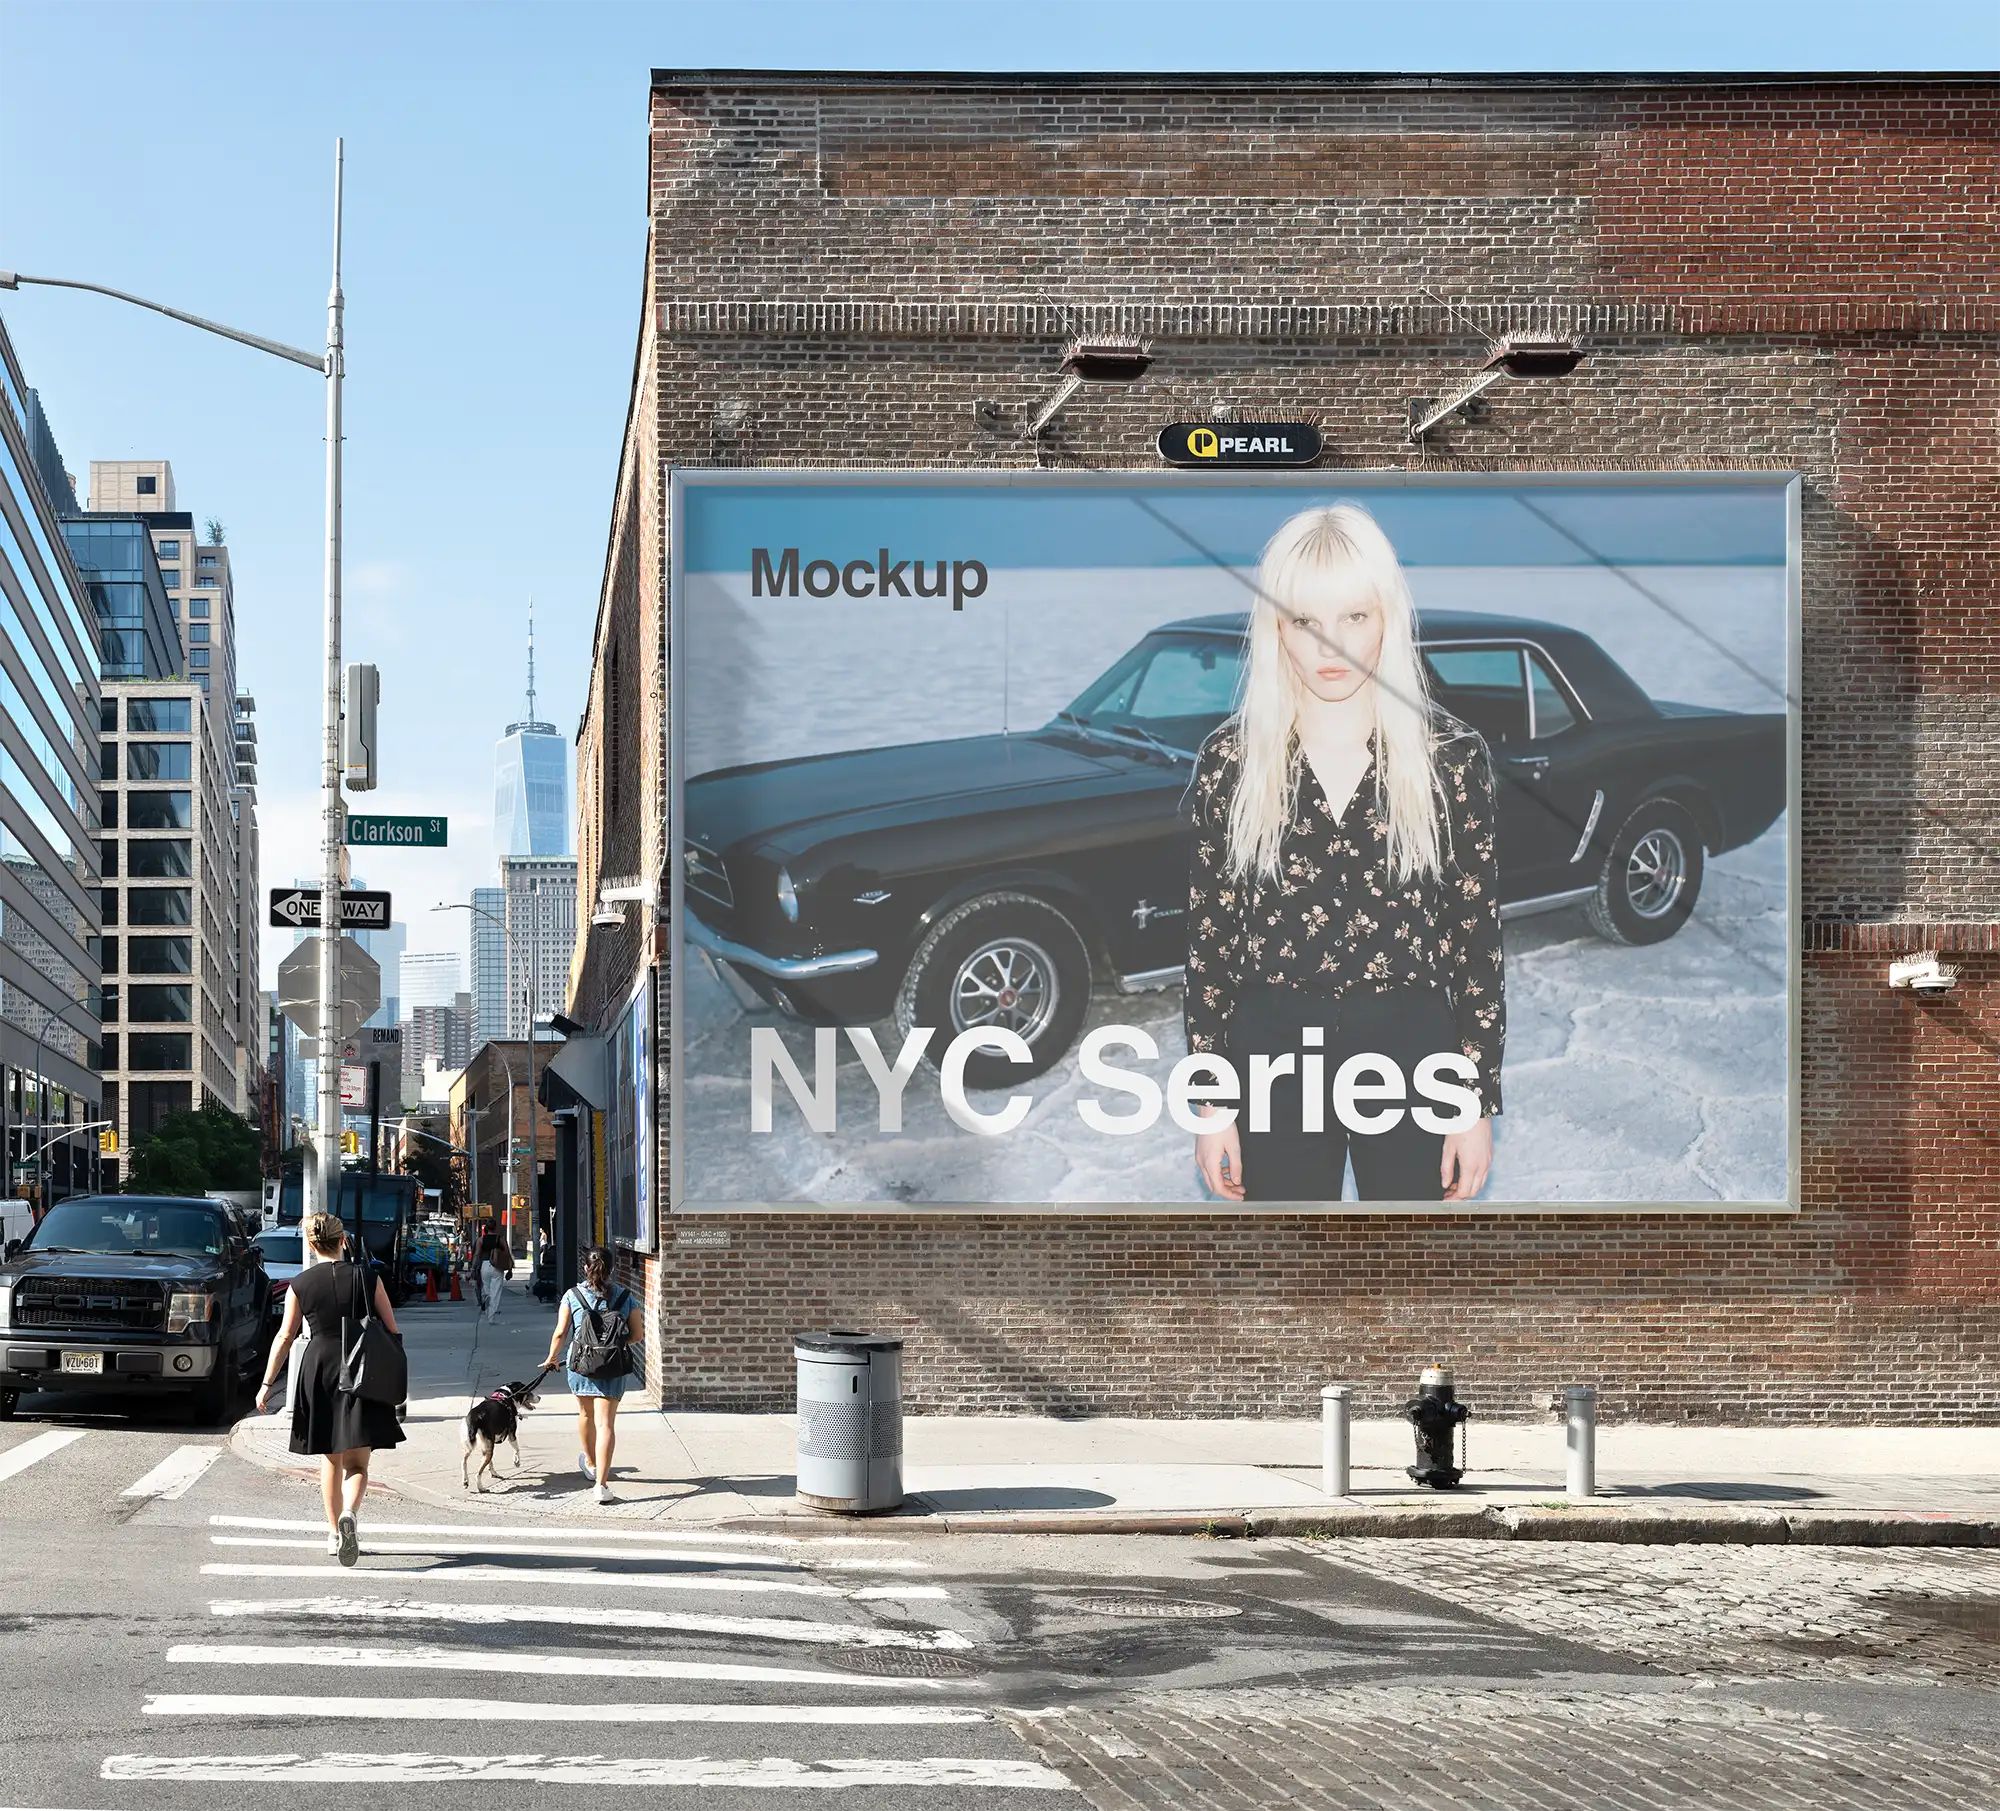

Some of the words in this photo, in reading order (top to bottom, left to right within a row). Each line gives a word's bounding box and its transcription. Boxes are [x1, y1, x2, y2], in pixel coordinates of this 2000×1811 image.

[1220, 437, 1293, 453] PEARL
[752, 548, 988, 611] Mockup
[352, 819, 423, 842] Clarkson
[430, 820, 441, 833] St
[286, 900, 321, 916] ONE
[342, 902, 380, 918] WAY
[750, 1026, 1033, 1135] NYC
[1077, 1025, 1482, 1135] Series
